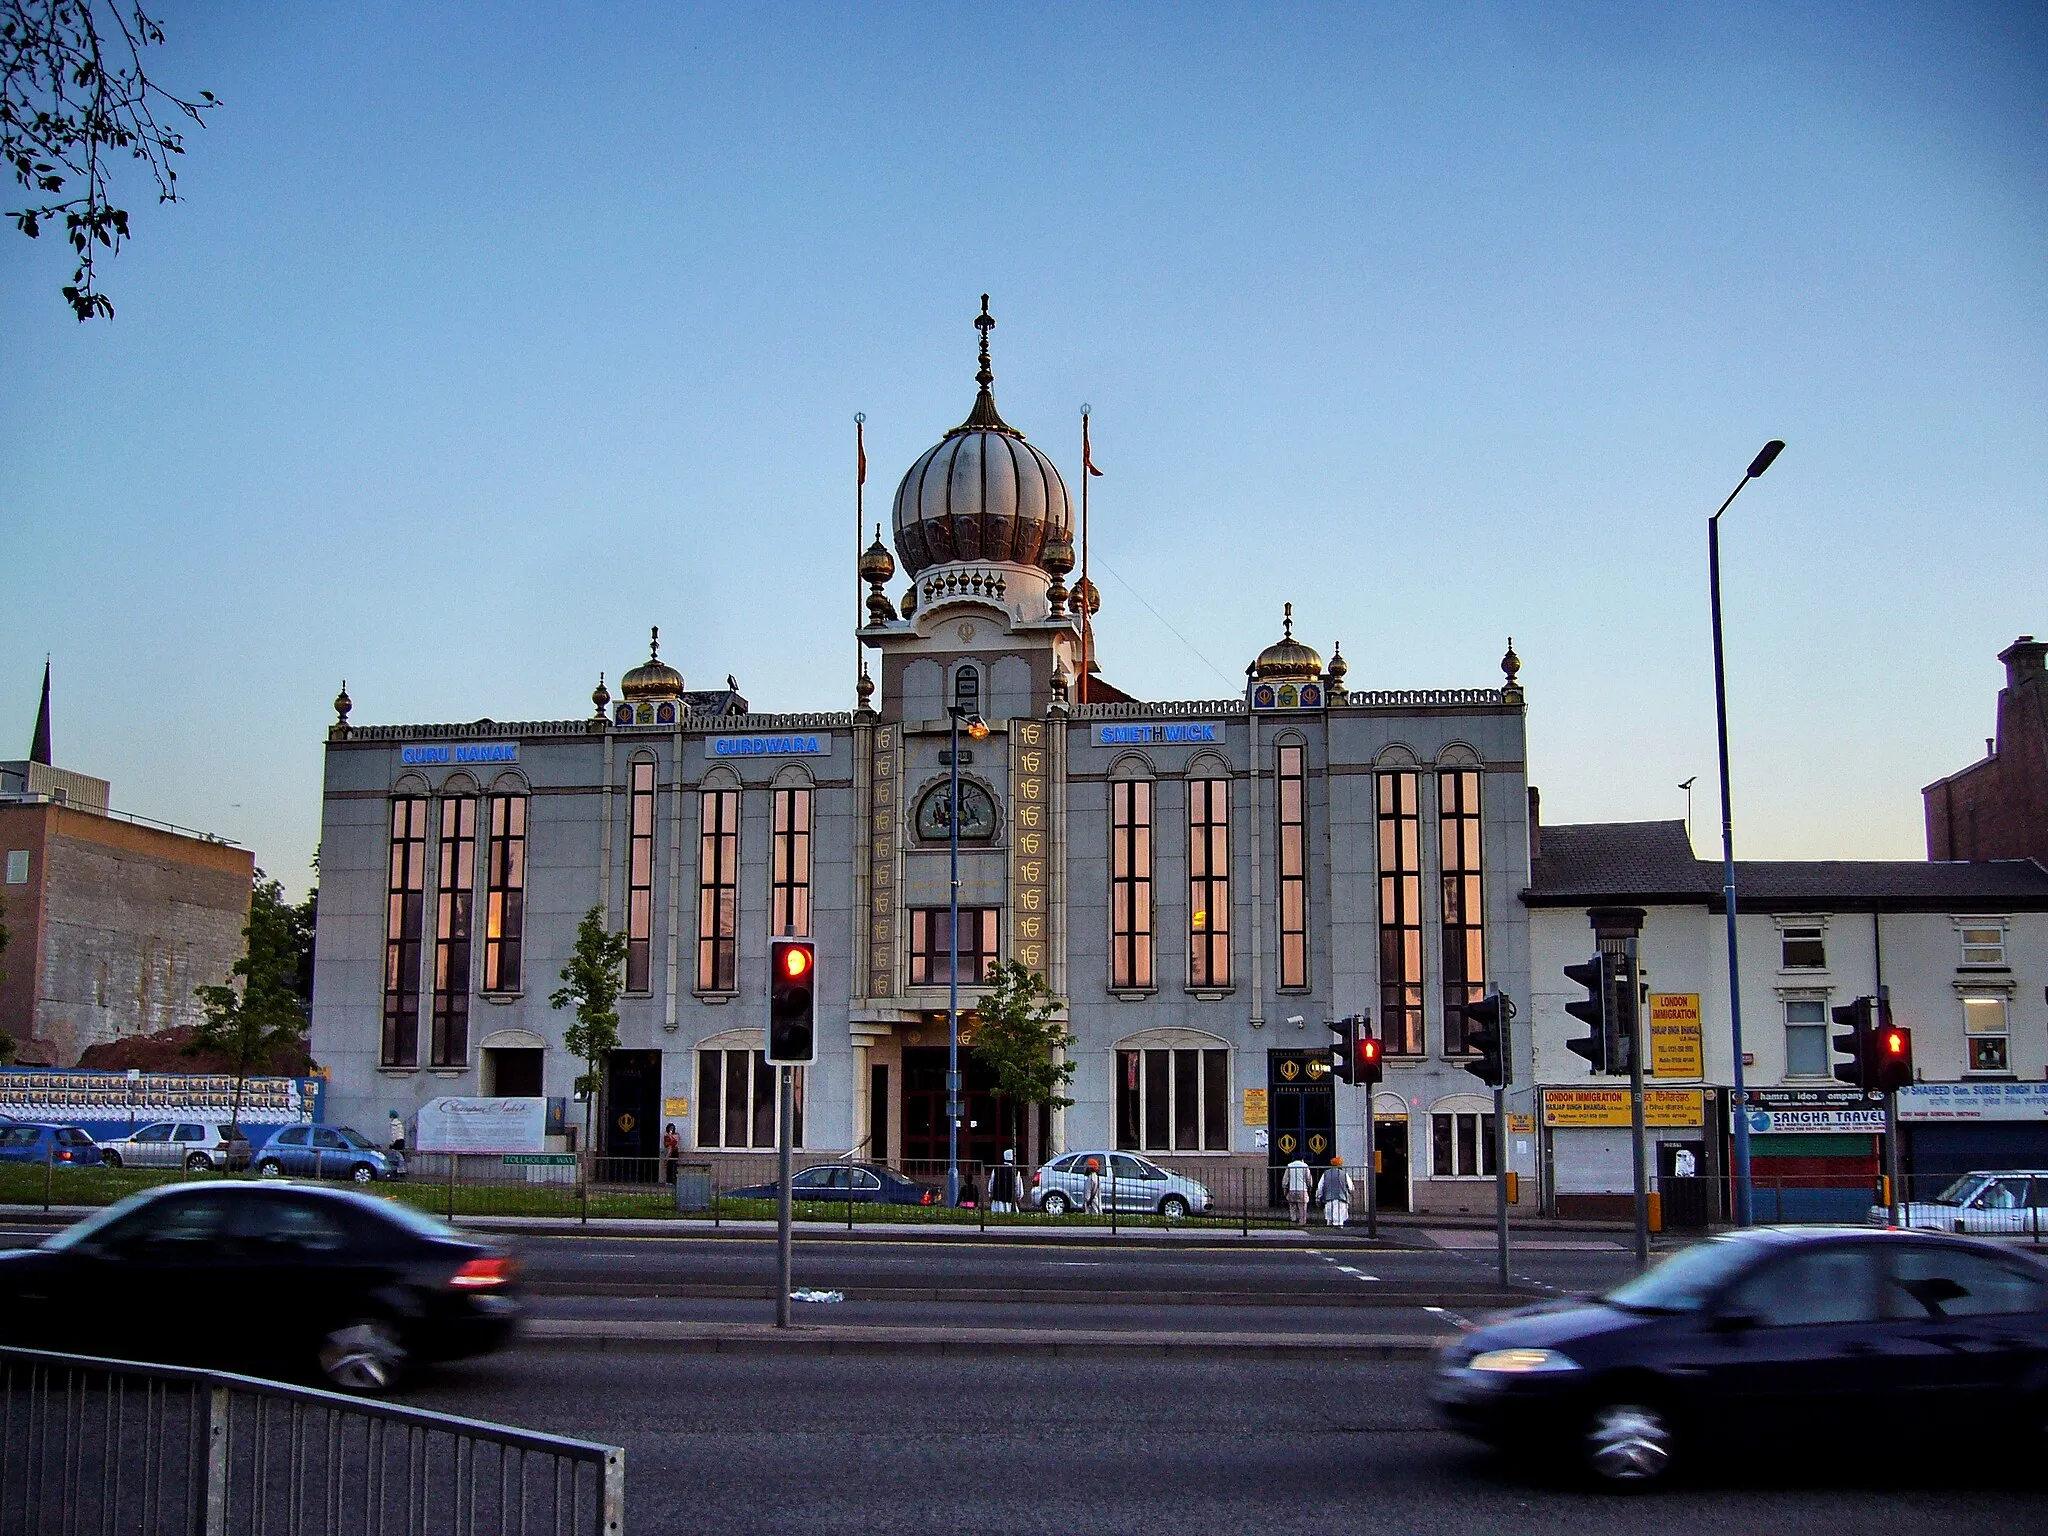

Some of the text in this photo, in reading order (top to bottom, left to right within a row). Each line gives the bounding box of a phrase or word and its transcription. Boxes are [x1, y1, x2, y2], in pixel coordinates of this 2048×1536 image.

[1101, 724, 1215, 744] SMETHWICK
[714, 737, 820, 756] GURDWARA
[402, 745, 517, 764] GURU NANAK
[1660, 996, 1688, 1007] LONDON
[1653, 1009, 1697, 1019] IMMIGRATION
[1910, 1086, 1950, 1096] SHAHEED
[1973, 1085, 2001, 1095] SUBEG
[2004, 1084, 2031, 1095] SINGH
[2034, 1084, 2048, 1095] LIB
[1545, 1092, 1622, 1102] LONDON IMMIGRATION
[1752, 1091, 1789, 1101] hamra
[1791, 1091, 1818, 1101] ideo
[1820, 1091, 1864, 1101] ompany
[1773, 1110, 1887, 1123] SANGHA TRAVEL
[505, 1156, 575, 1164] TOLLHOUSE WAY
